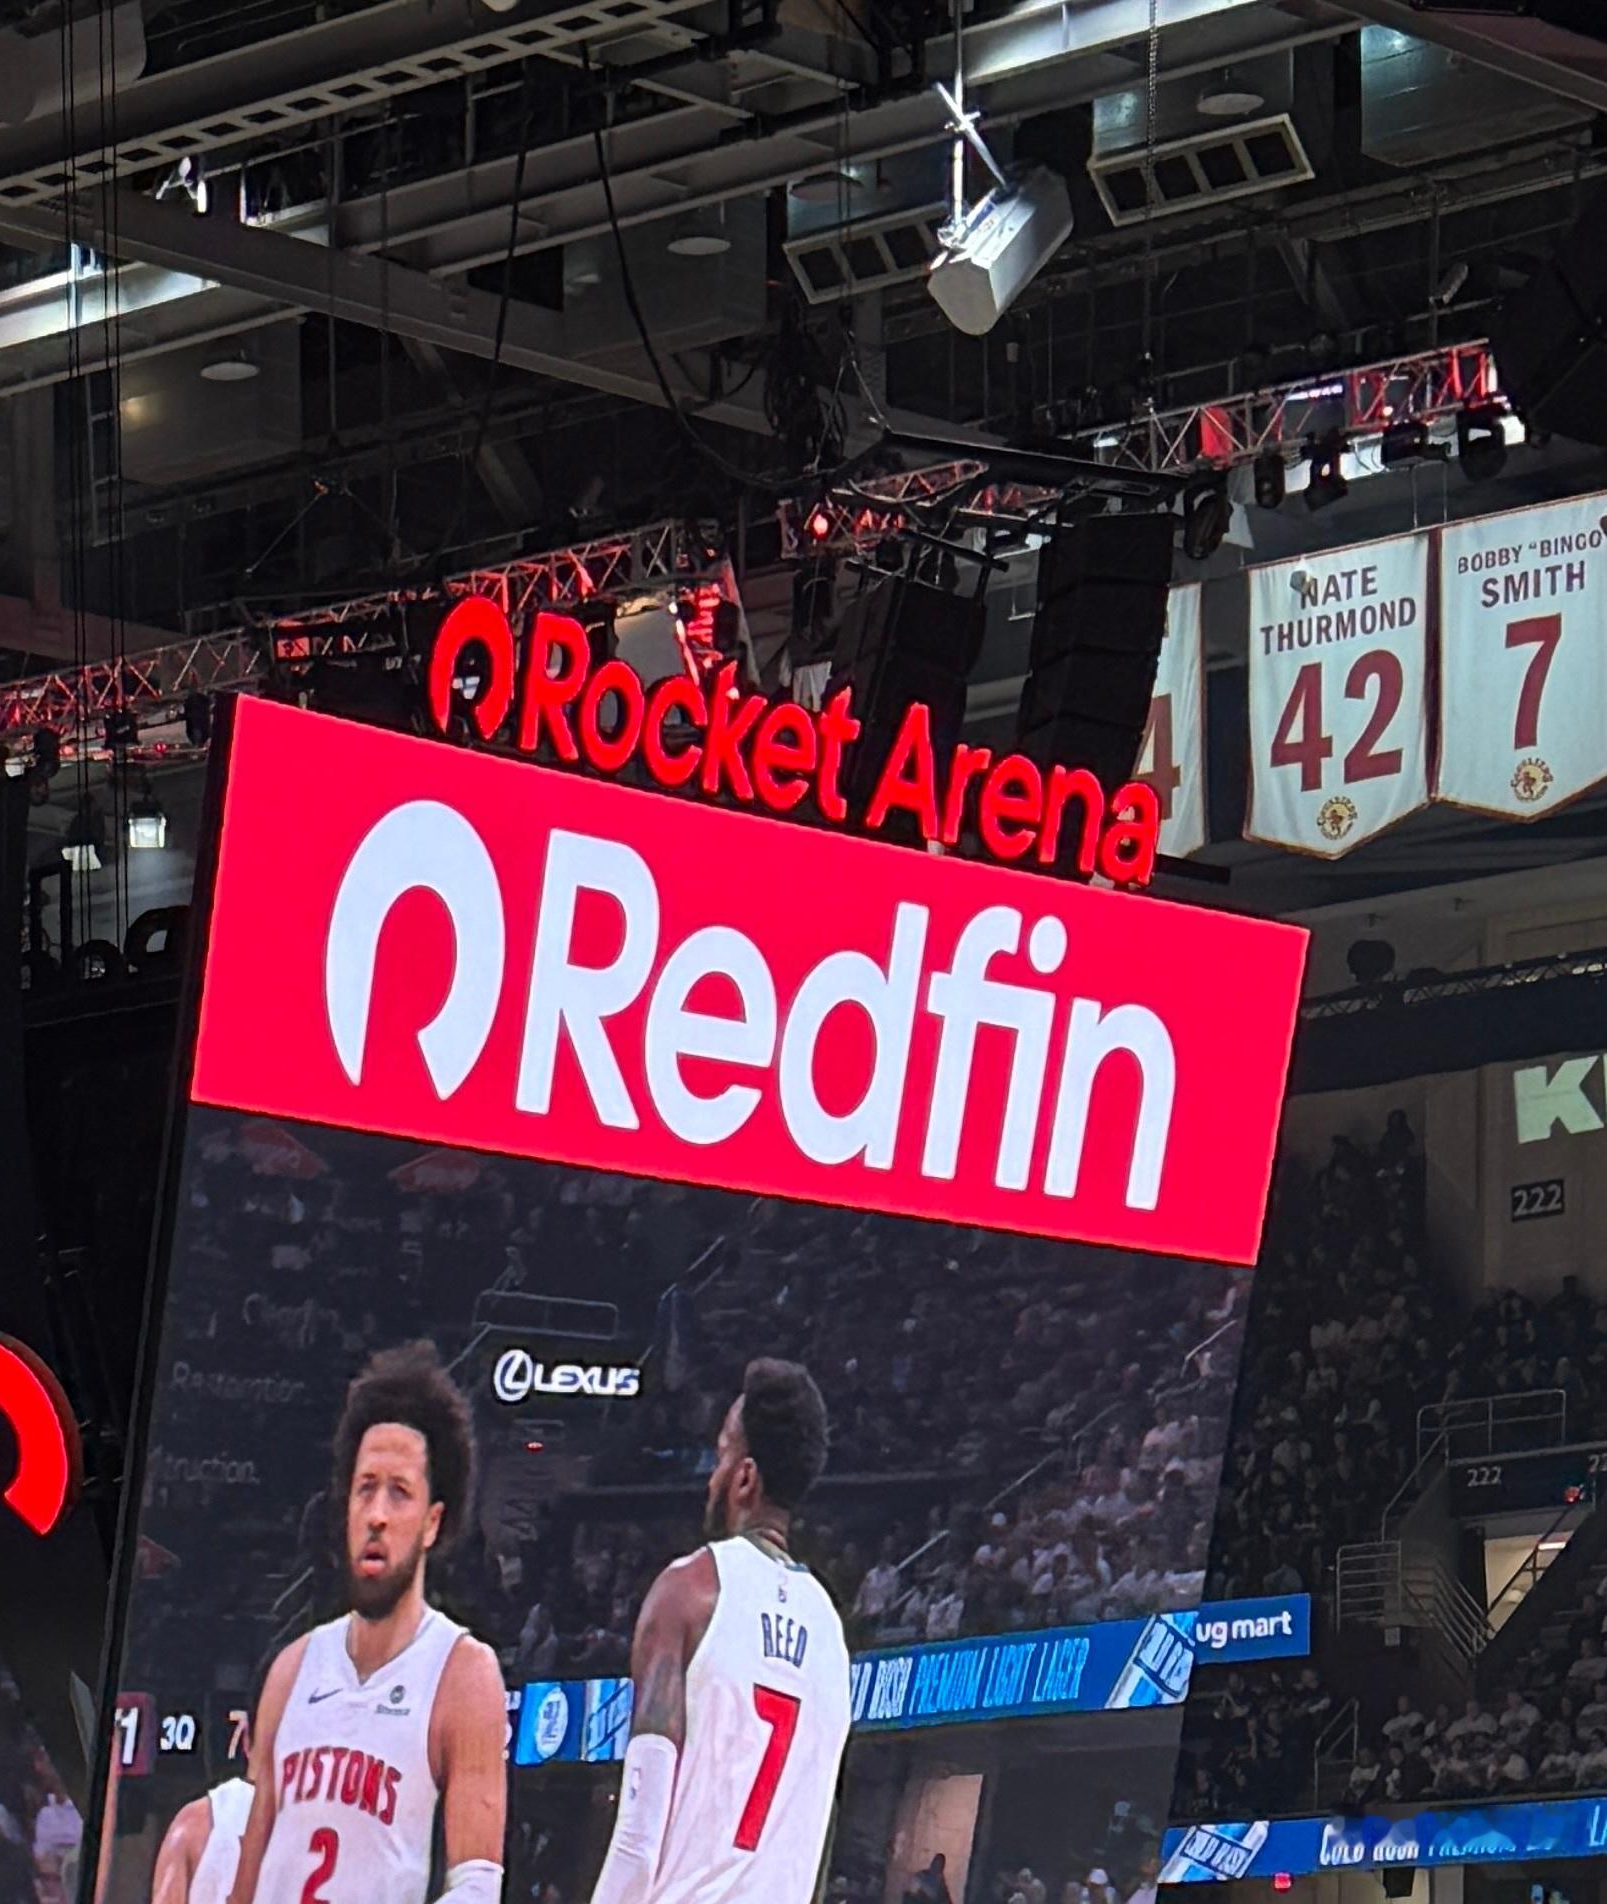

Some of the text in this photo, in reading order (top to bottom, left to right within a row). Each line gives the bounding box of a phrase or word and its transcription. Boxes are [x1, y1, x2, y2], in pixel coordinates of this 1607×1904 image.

[1298, 565, 1379, 612] NATE
[1457, 546, 1522, 576] BOBBY
[1481, 564, 1586, 609] SMITH
[1260, 596, 1417, 656] THURMOND
[1504, 611, 1563, 751] 7
[518, 608, 1162, 888] Rocket Arena
[1270, 648, 1405, 793] 42
[515, 826, 1177, 1212] Redfin
[1512, 1182, 1564, 1219] 222
[532, 1364, 642, 1396] LEXUS
[759, 1610, 810, 1670] REED
[1231, 1610, 1294, 1642] mart
[159, 1715, 197, 1752] 3Q
[280, 1745, 404, 1827] PISTONS
[732, 1682, 802, 1853] 7
